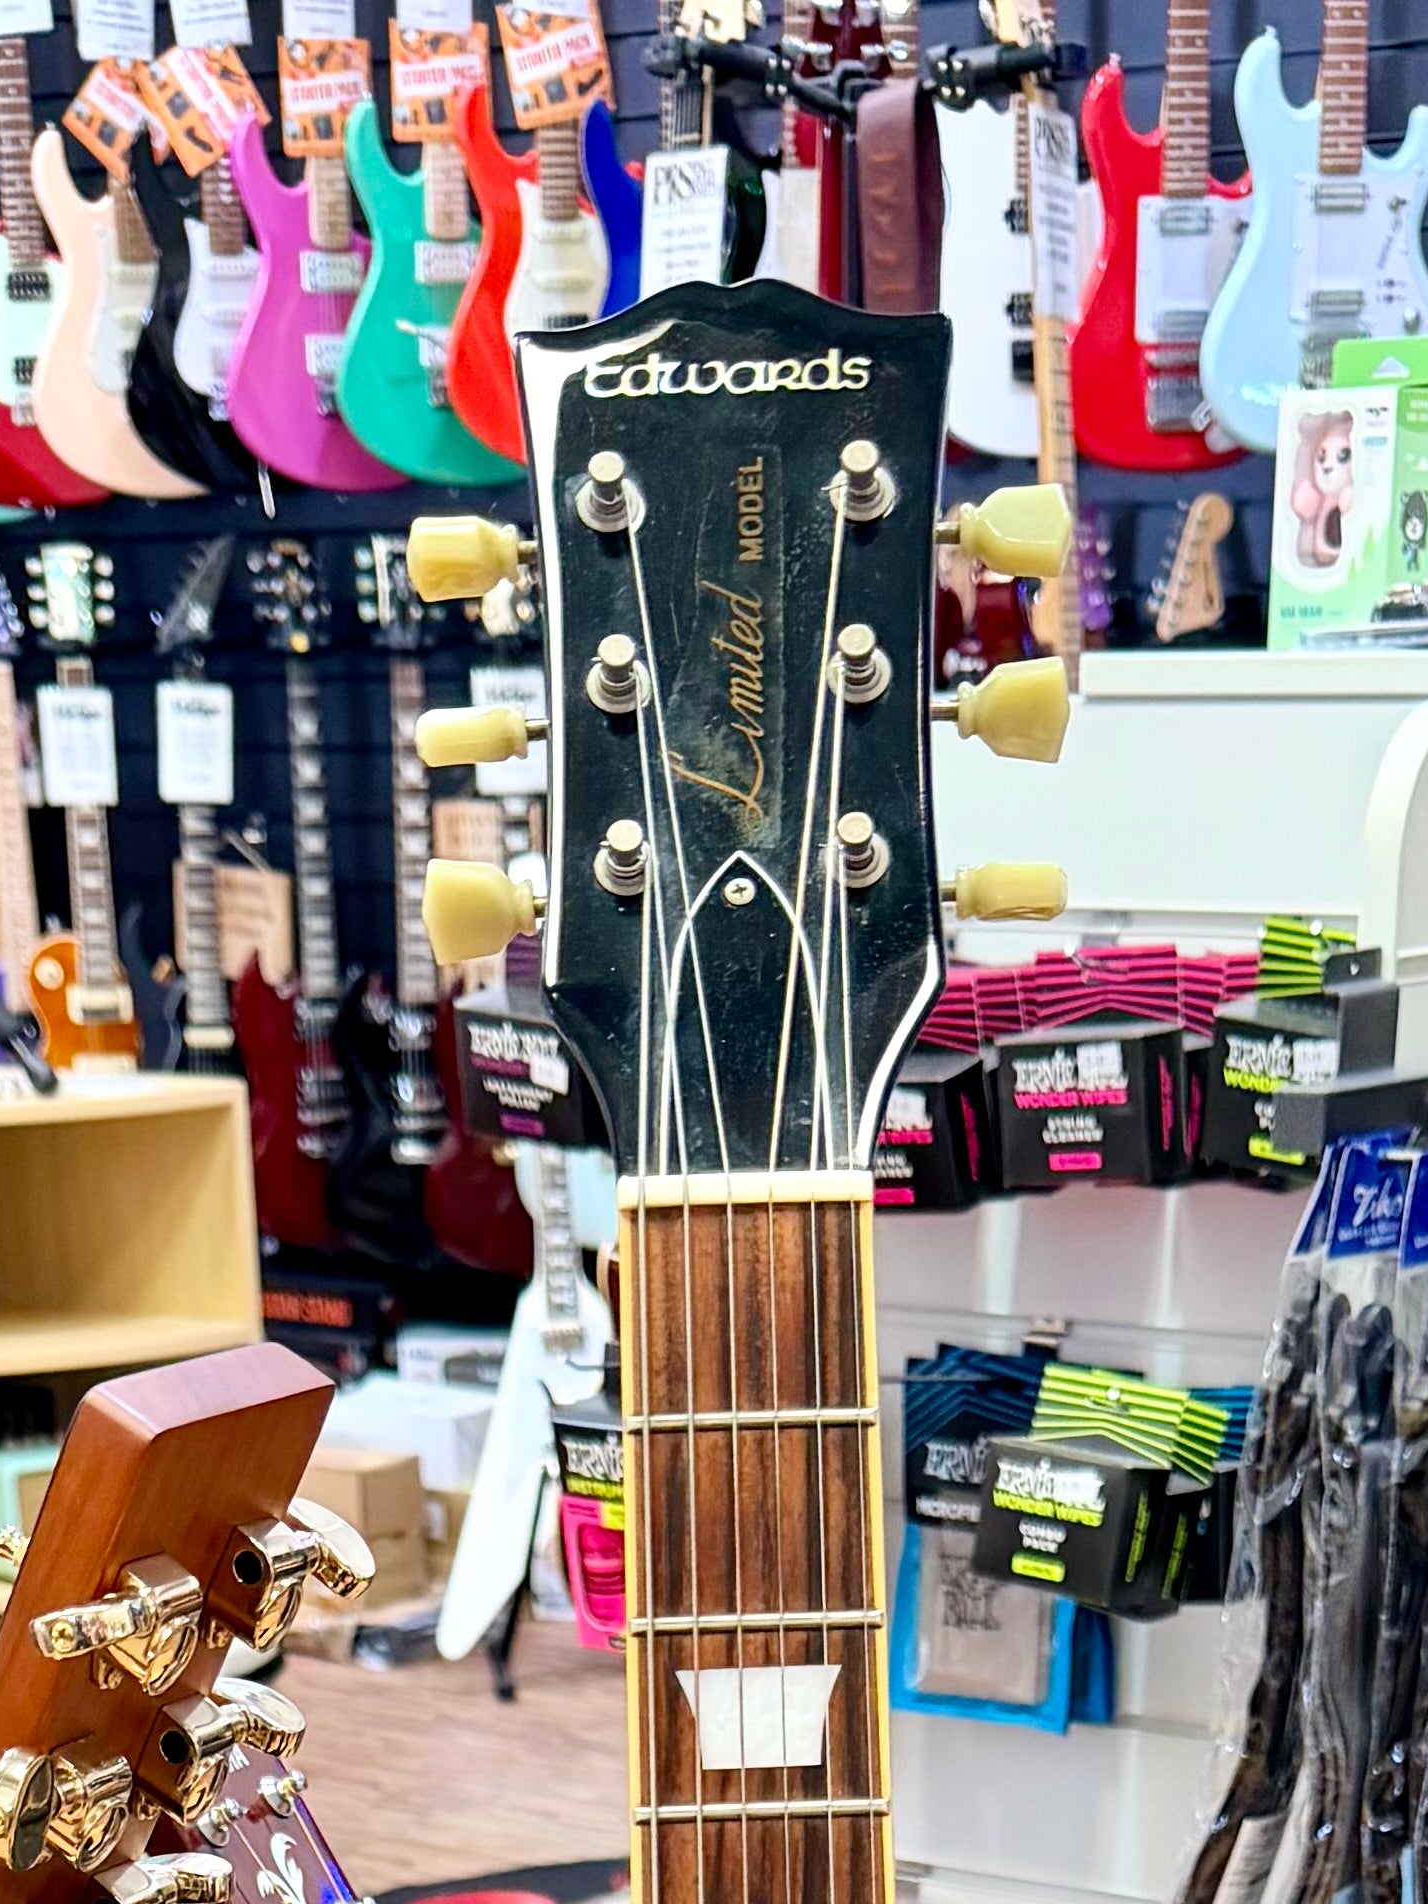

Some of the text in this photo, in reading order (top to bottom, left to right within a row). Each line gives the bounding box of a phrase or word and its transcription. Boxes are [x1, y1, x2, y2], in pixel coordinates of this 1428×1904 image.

[583, 347, 873, 399] Edwards
[665, 455, 766, 834] Limited MODEL
[562, 1431, 624, 1483] ERNI
[924, 1435, 989, 1485] ERNI
